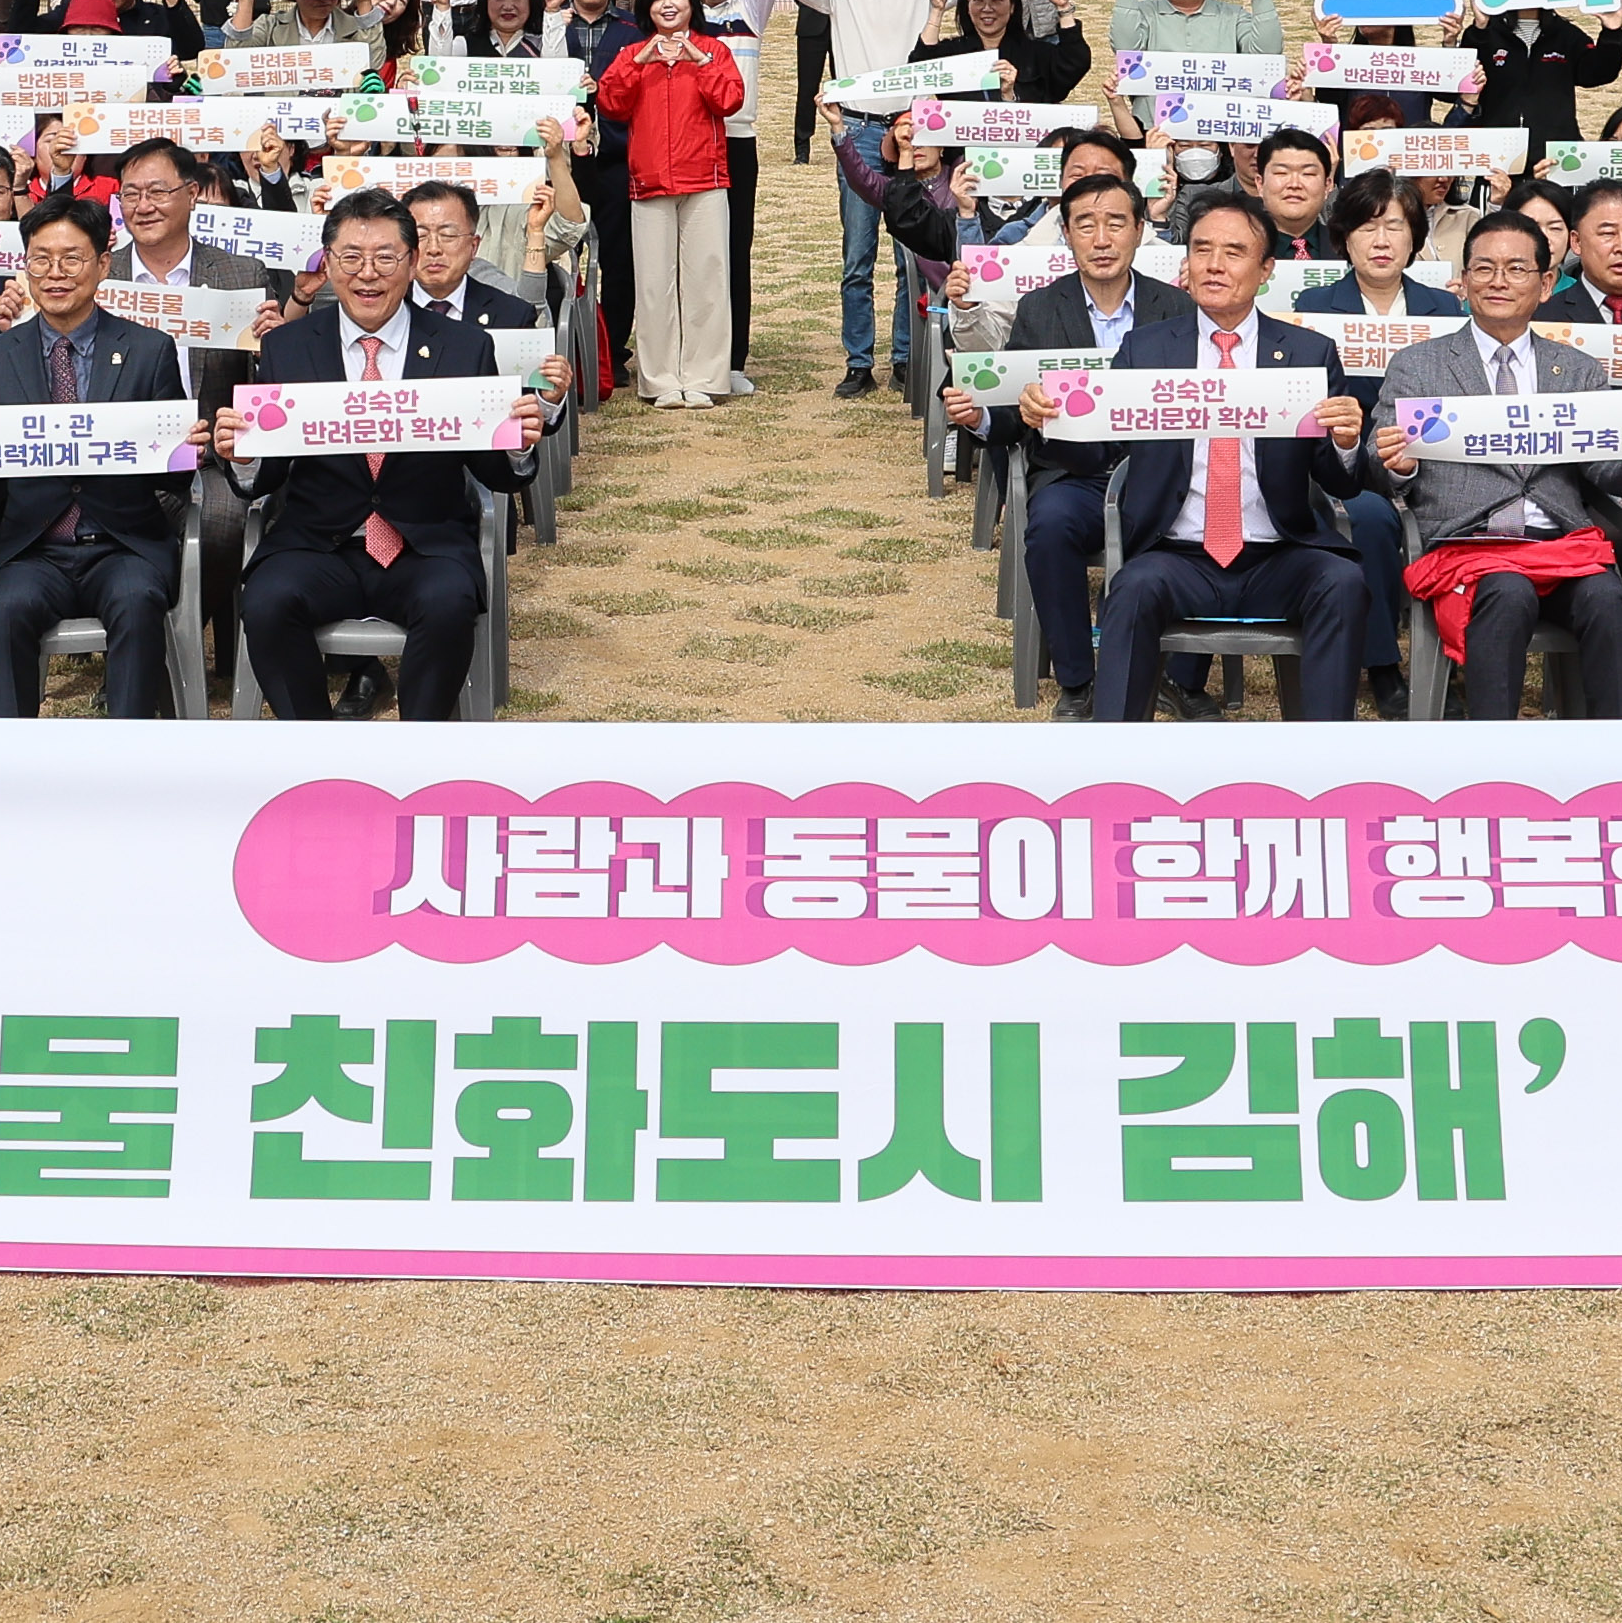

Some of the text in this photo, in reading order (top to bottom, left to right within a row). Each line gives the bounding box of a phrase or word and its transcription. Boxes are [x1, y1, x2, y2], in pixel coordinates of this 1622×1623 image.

[250, 52, 313, 67] 반려동물
[1370, 52, 1416, 67] 성숙한
[302, 68, 334, 84] 구축
[467, 63, 531, 78] 동물복지
[1344, 67, 1442, 85] 반려문화 확산
[18, 73, 85, 89] 반려동물
[872, 71, 954, 93] 인프라 확충
[1155, 75, 1252, 92] 협력체계 구축
[128, 109, 201, 125] 반려동물
[288, 118, 321, 133] 구축
[982, 109, 1031, 125] 성숙한
[188, 127, 225, 145] 구축
[456, 119, 492, 138] 확충
[955, 127, 1021, 143] 반려문화
[1197, 119, 1262, 137] 협력체계
[1404, 135, 1470, 151] 반려동물
[395, 161, 473, 178] 반려동물
[1458, 154, 1491, 170] 구축
[95, 288, 183, 315] 반려동물
[166, 319, 211, 341] 구축
[1151, 379, 1227, 404] 성숙한
[343, 389, 419, 415] 성숙한
[1109, 406, 1269, 432] 반려문화 확산
[302, 416, 462, 446] 반려문화 확산
[1463, 429, 1620, 458] 협력체계 구축
[86, 441, 138, 465] 구축
[389, 814, 728, 919] 사람과
[760, 815, 1093, 921] 동물이
[1128, 815, 1350, 920] 함께
[248, 1013, 1043, 1204] 친화도시
